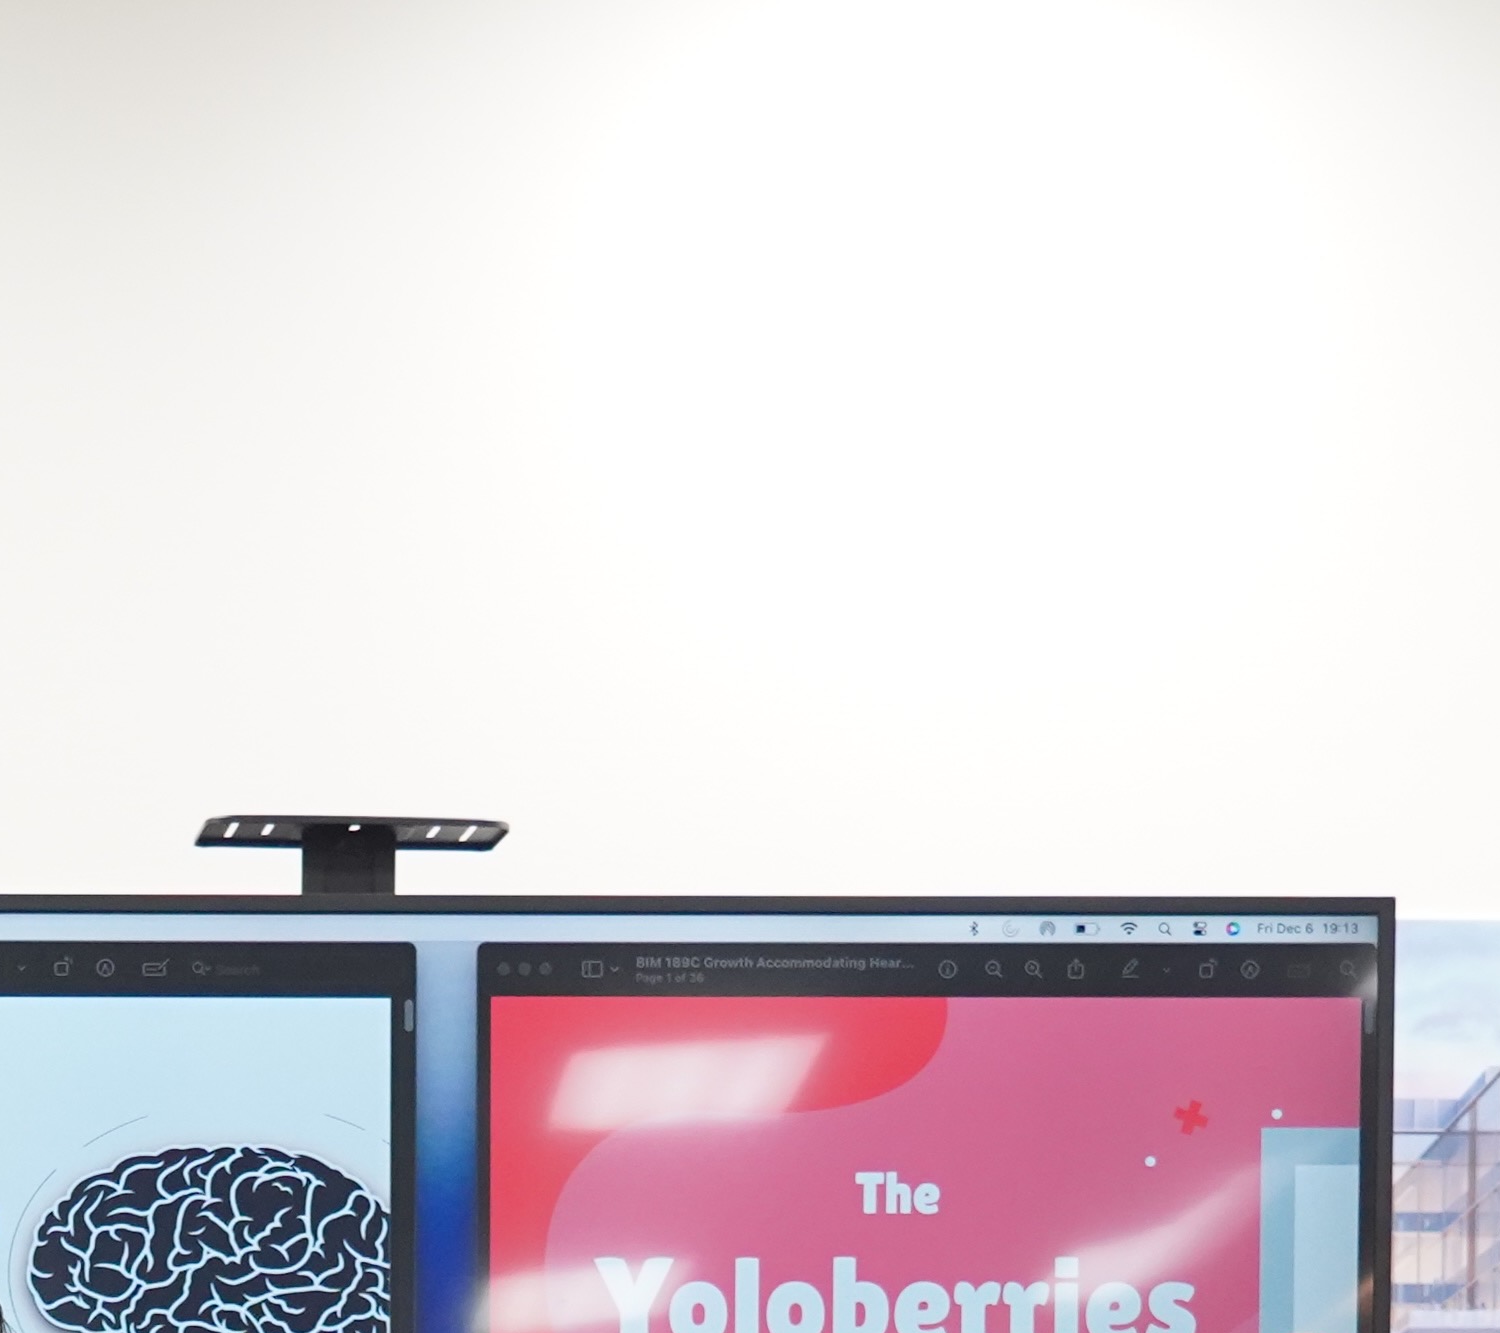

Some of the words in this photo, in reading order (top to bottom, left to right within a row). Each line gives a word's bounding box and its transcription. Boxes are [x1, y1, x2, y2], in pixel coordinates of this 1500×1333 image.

[1257, 923, 1273, 935] Fri
[1276, 923, 1302, 935] Dec
[1305, 923, 1314, 935] 6
[1323, 923, 1359, 935] 19:13
[703, 956, 754, 969] Growth
[756, 956, 866, 971] Accommodating
[855, 1171, 940, 1216] The
